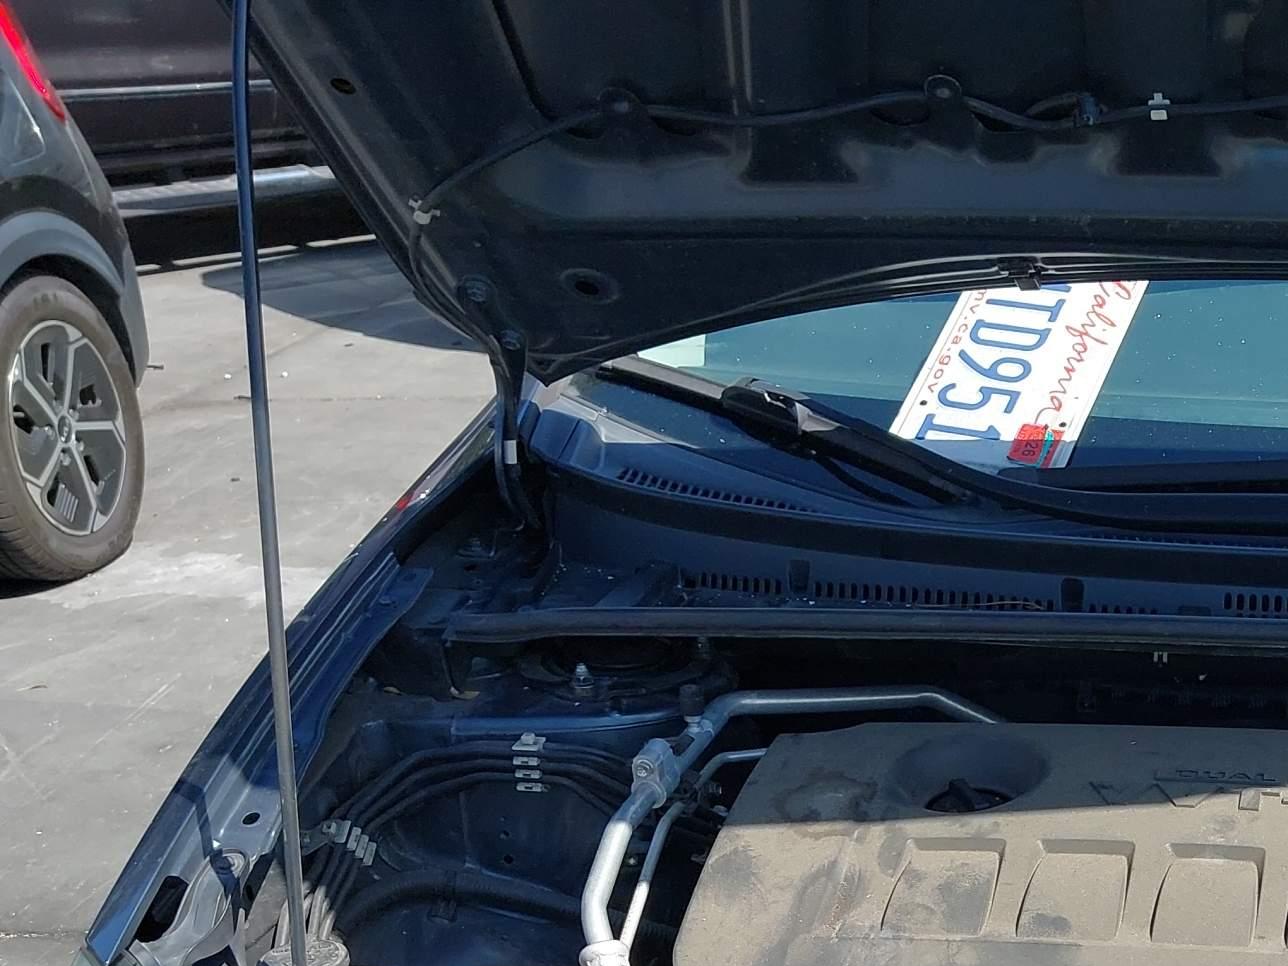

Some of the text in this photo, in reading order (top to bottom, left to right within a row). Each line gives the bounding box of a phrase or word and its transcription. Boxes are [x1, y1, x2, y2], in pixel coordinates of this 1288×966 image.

[927, 289, 988, 393] mv.ca.gov
[1021, 442, 1040, 457] 26
[1175, 768, 1279, 782] DUAL
